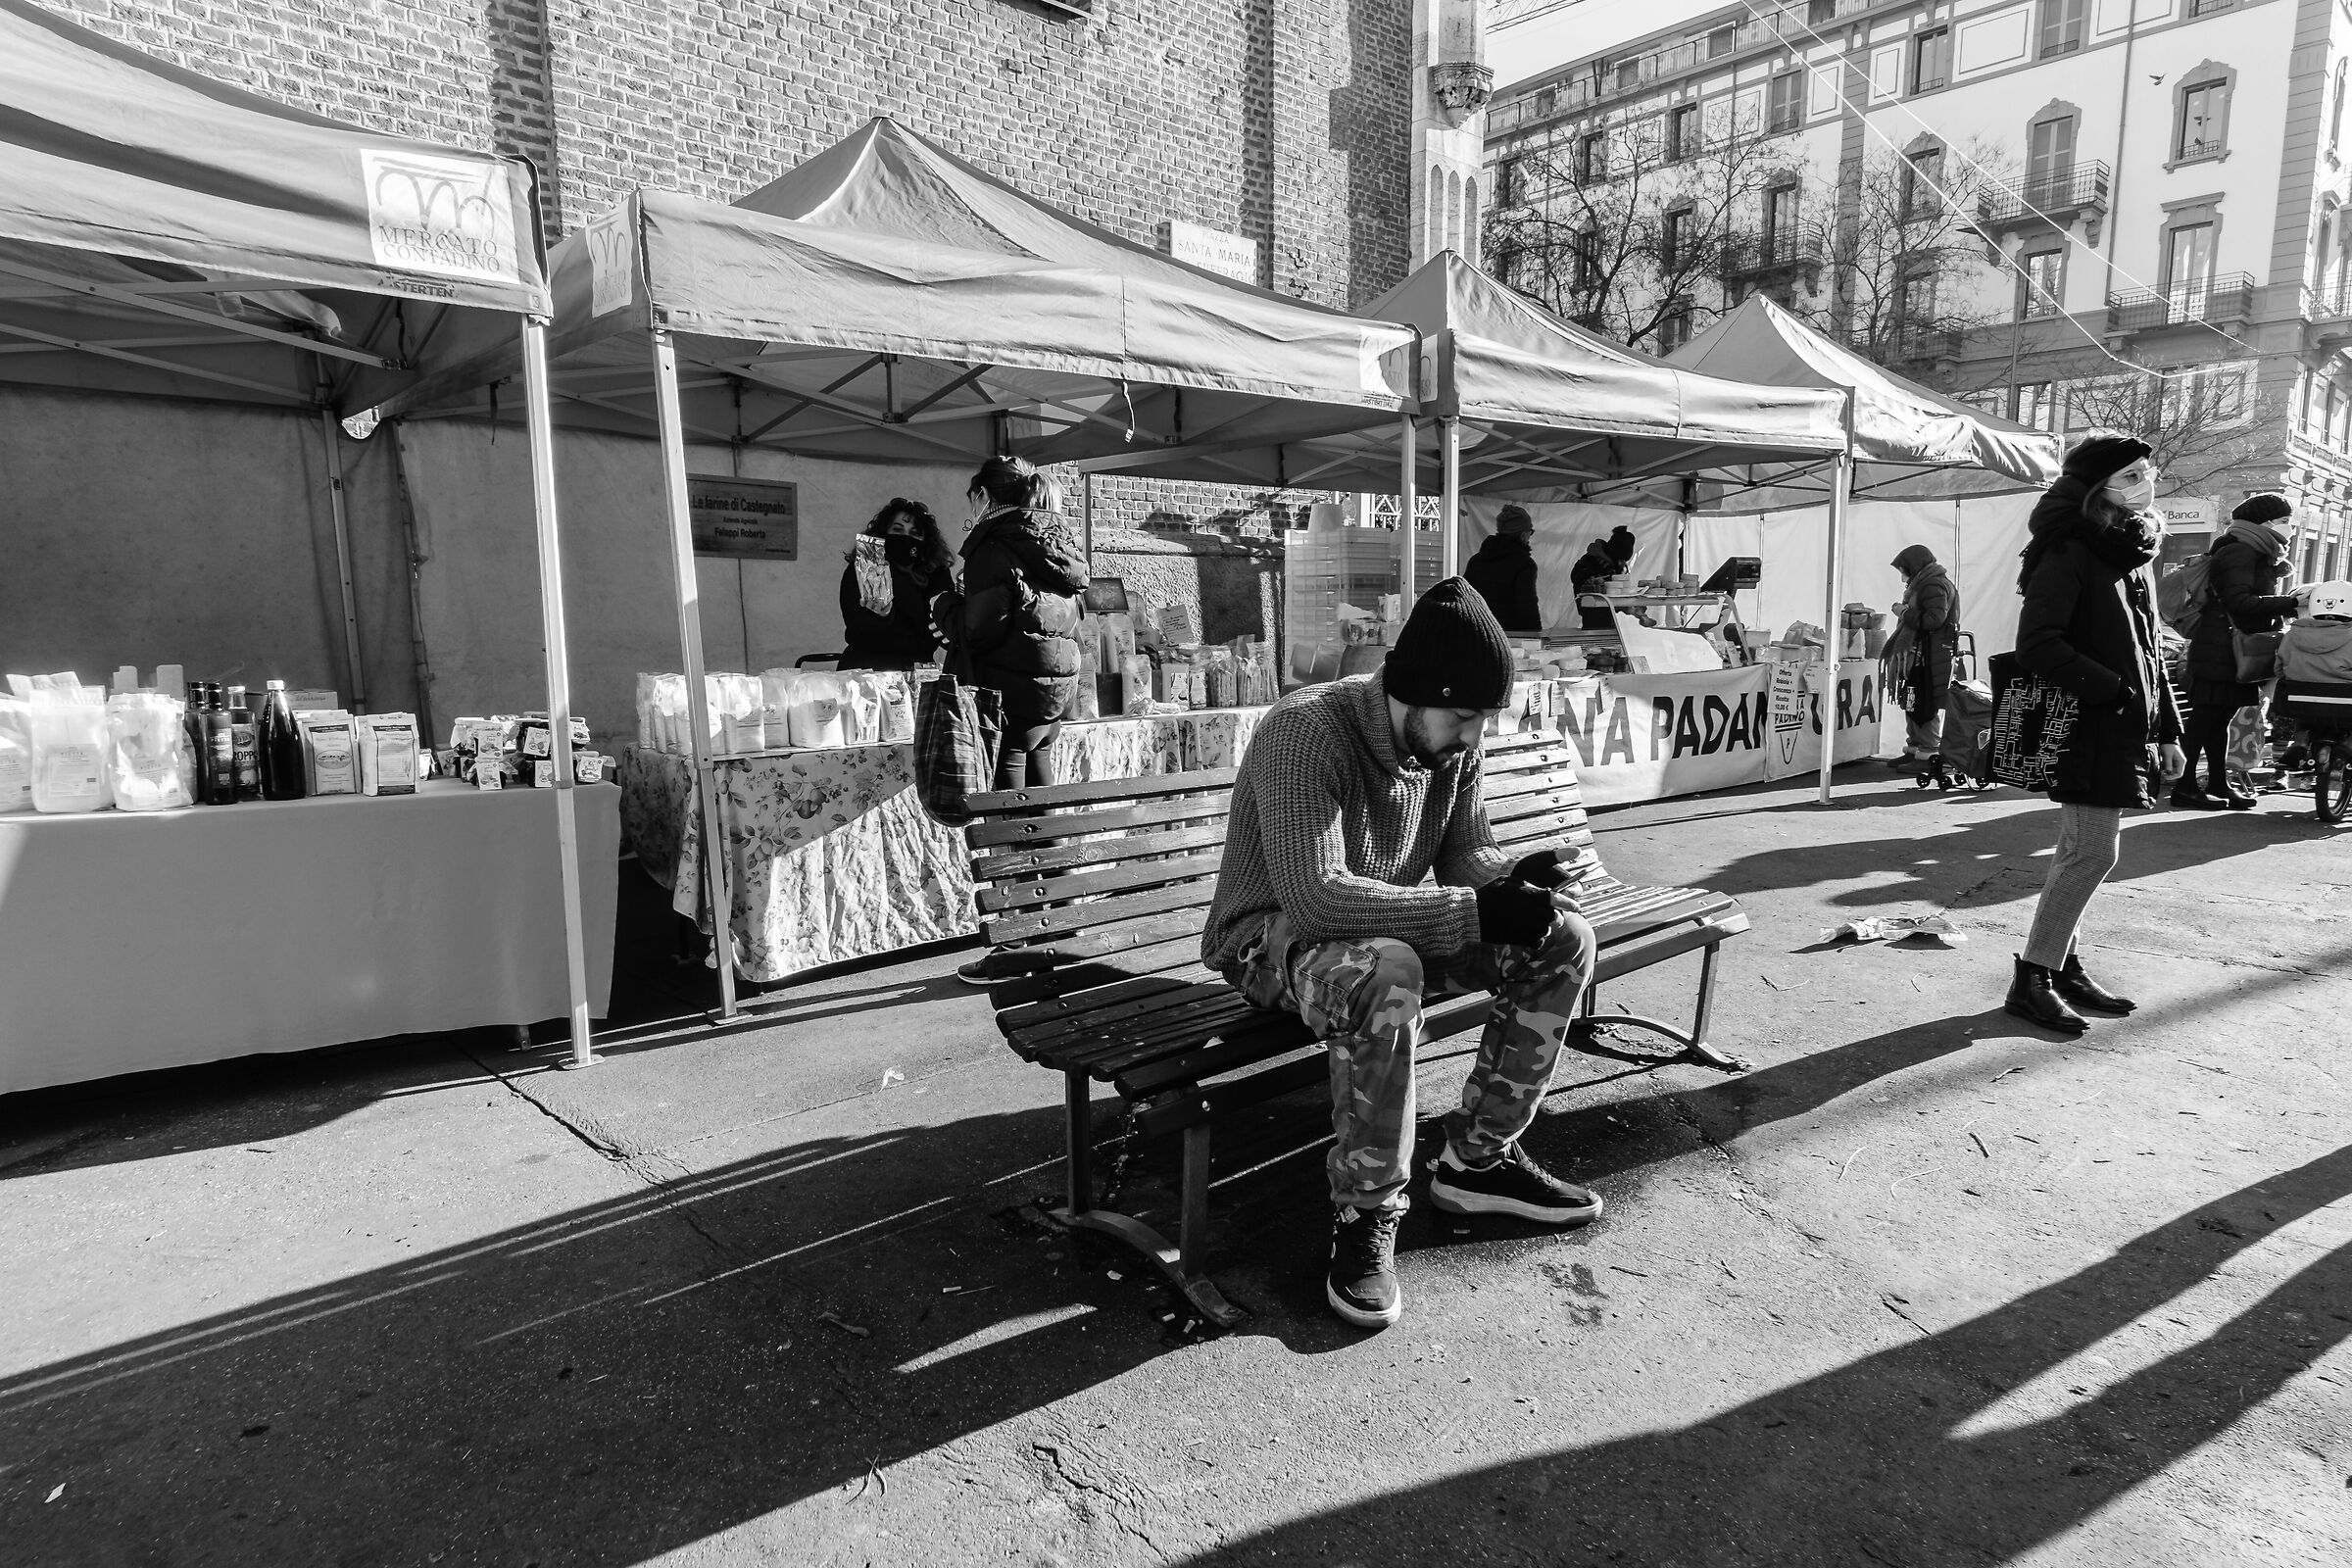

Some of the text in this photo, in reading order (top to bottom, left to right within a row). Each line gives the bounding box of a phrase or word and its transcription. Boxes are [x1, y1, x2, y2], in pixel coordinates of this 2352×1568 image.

[379, 224, 498, 257] MERCATO
[1178, 240, 1251, 267] SANTA MARIA
[383, 243, 501, 272] CONTADINO
[692, 495, 786, 515] Le farine di Castegnato
[2168, 511, 2200, 520] Banca
[1650, 691, 1768, 761] PADAN
